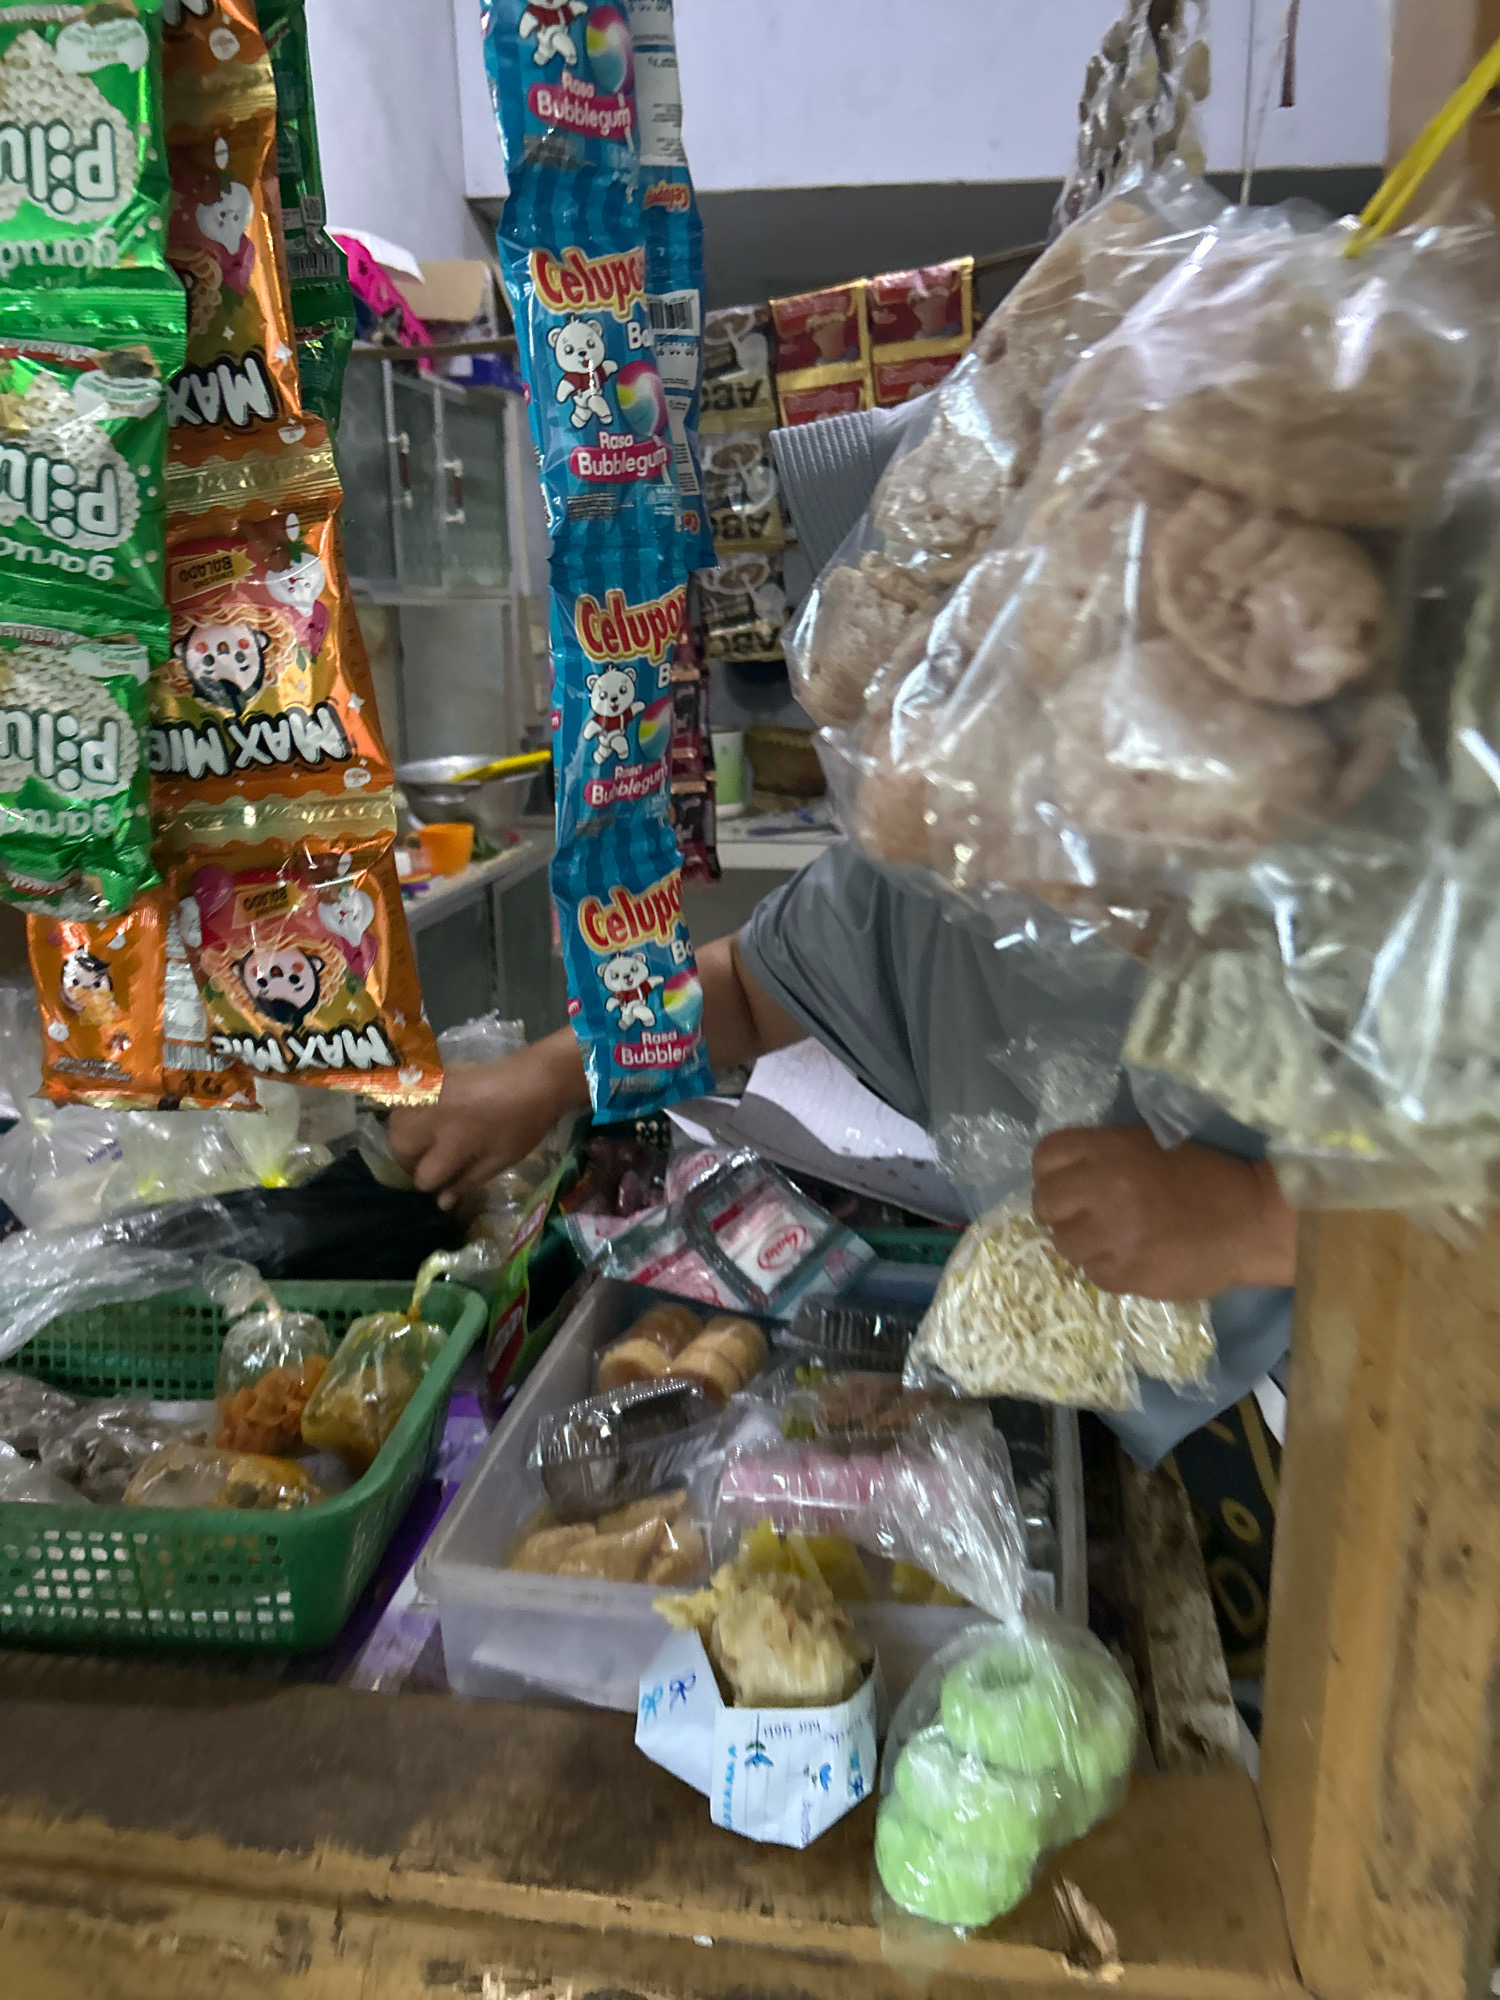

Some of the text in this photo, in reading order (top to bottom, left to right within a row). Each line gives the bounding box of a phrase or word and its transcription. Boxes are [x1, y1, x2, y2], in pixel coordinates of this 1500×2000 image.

[536, 89, 632, 136] Bubblegum
[599, 431, 634, 449] Rasa
[577, 447, 669, 477] Bubblegum
[229, 704, 350, 768] MAX
[592, 763, 668, 804] Bubblegum
[288, 1027, 395, 1071] MAX
[642, 1030, 677, 1046] Rasa
